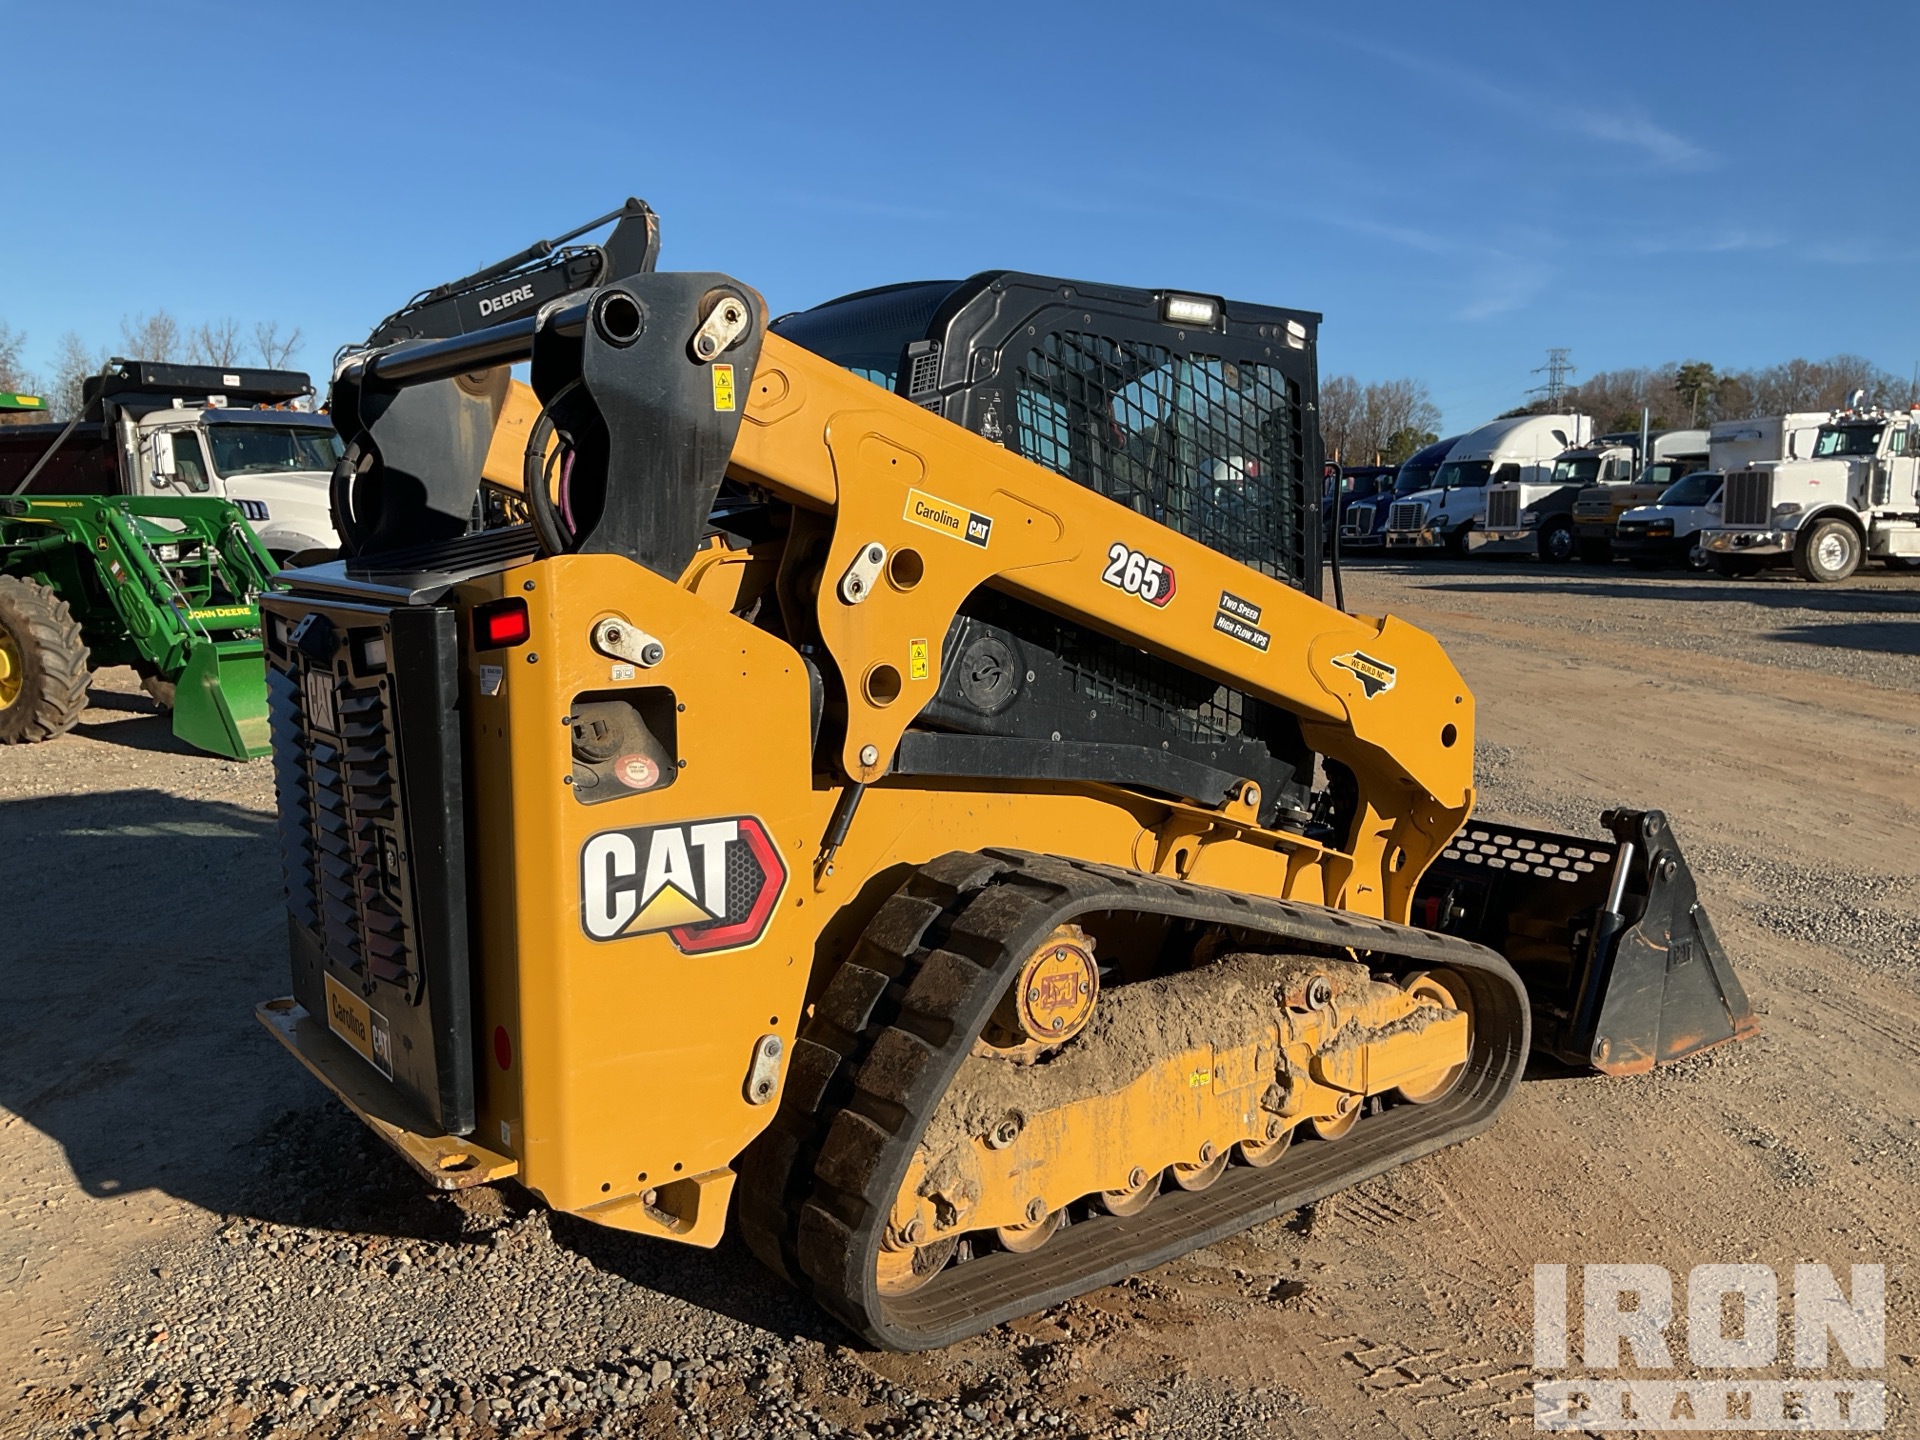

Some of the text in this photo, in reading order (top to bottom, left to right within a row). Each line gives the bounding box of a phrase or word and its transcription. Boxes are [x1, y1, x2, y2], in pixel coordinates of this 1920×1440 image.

[479, 284, 534, 317] DEERE
[915, 501, 989, 540] Carolina CAT
[1103, 544, 1164, 600] 265
[1250, 632, 1268, 647] XPS
[1350, 658, 1385, 680] WE BUILD NC
[307, 672, 334, 731] CAT
[584, 820, 738, 938] CAT
[332, 992, 390, 1062] Carolina CAT
